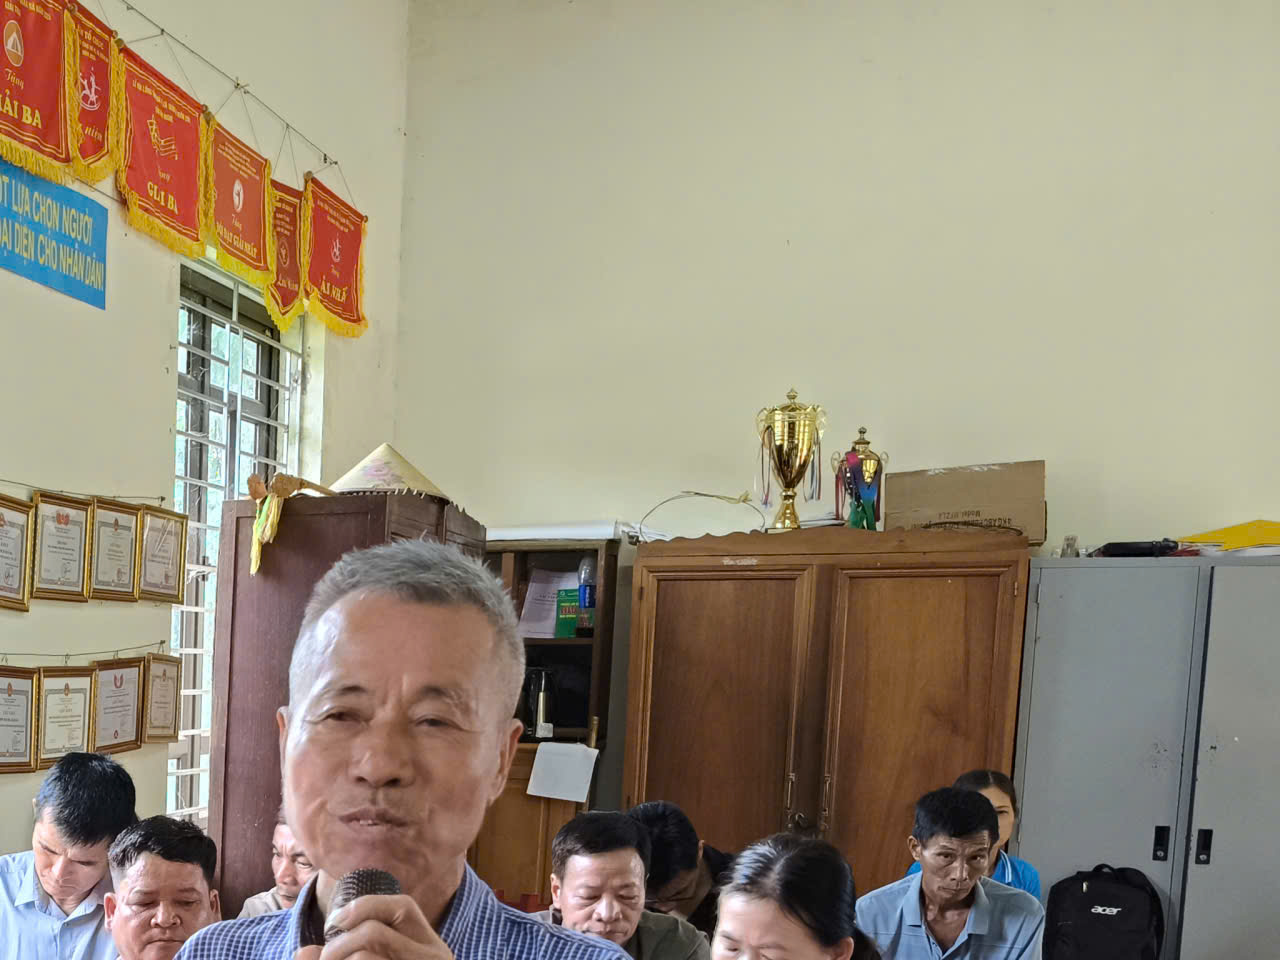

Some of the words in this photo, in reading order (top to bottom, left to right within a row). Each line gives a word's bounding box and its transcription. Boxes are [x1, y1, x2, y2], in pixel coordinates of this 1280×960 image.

[22, 104, 42, 128] BA
[12, 179, 32, 220] LỰA
[32, 191, 60, 235] CHỌN
[62, 204, 94, 247] NGƯỜI
[14, 219, 35, 265] DIỆN
[37, 233, 59, 270] CHO
[59, 242, 84, 283] NHÂN
[1091, 905, 1122, 915] acer
